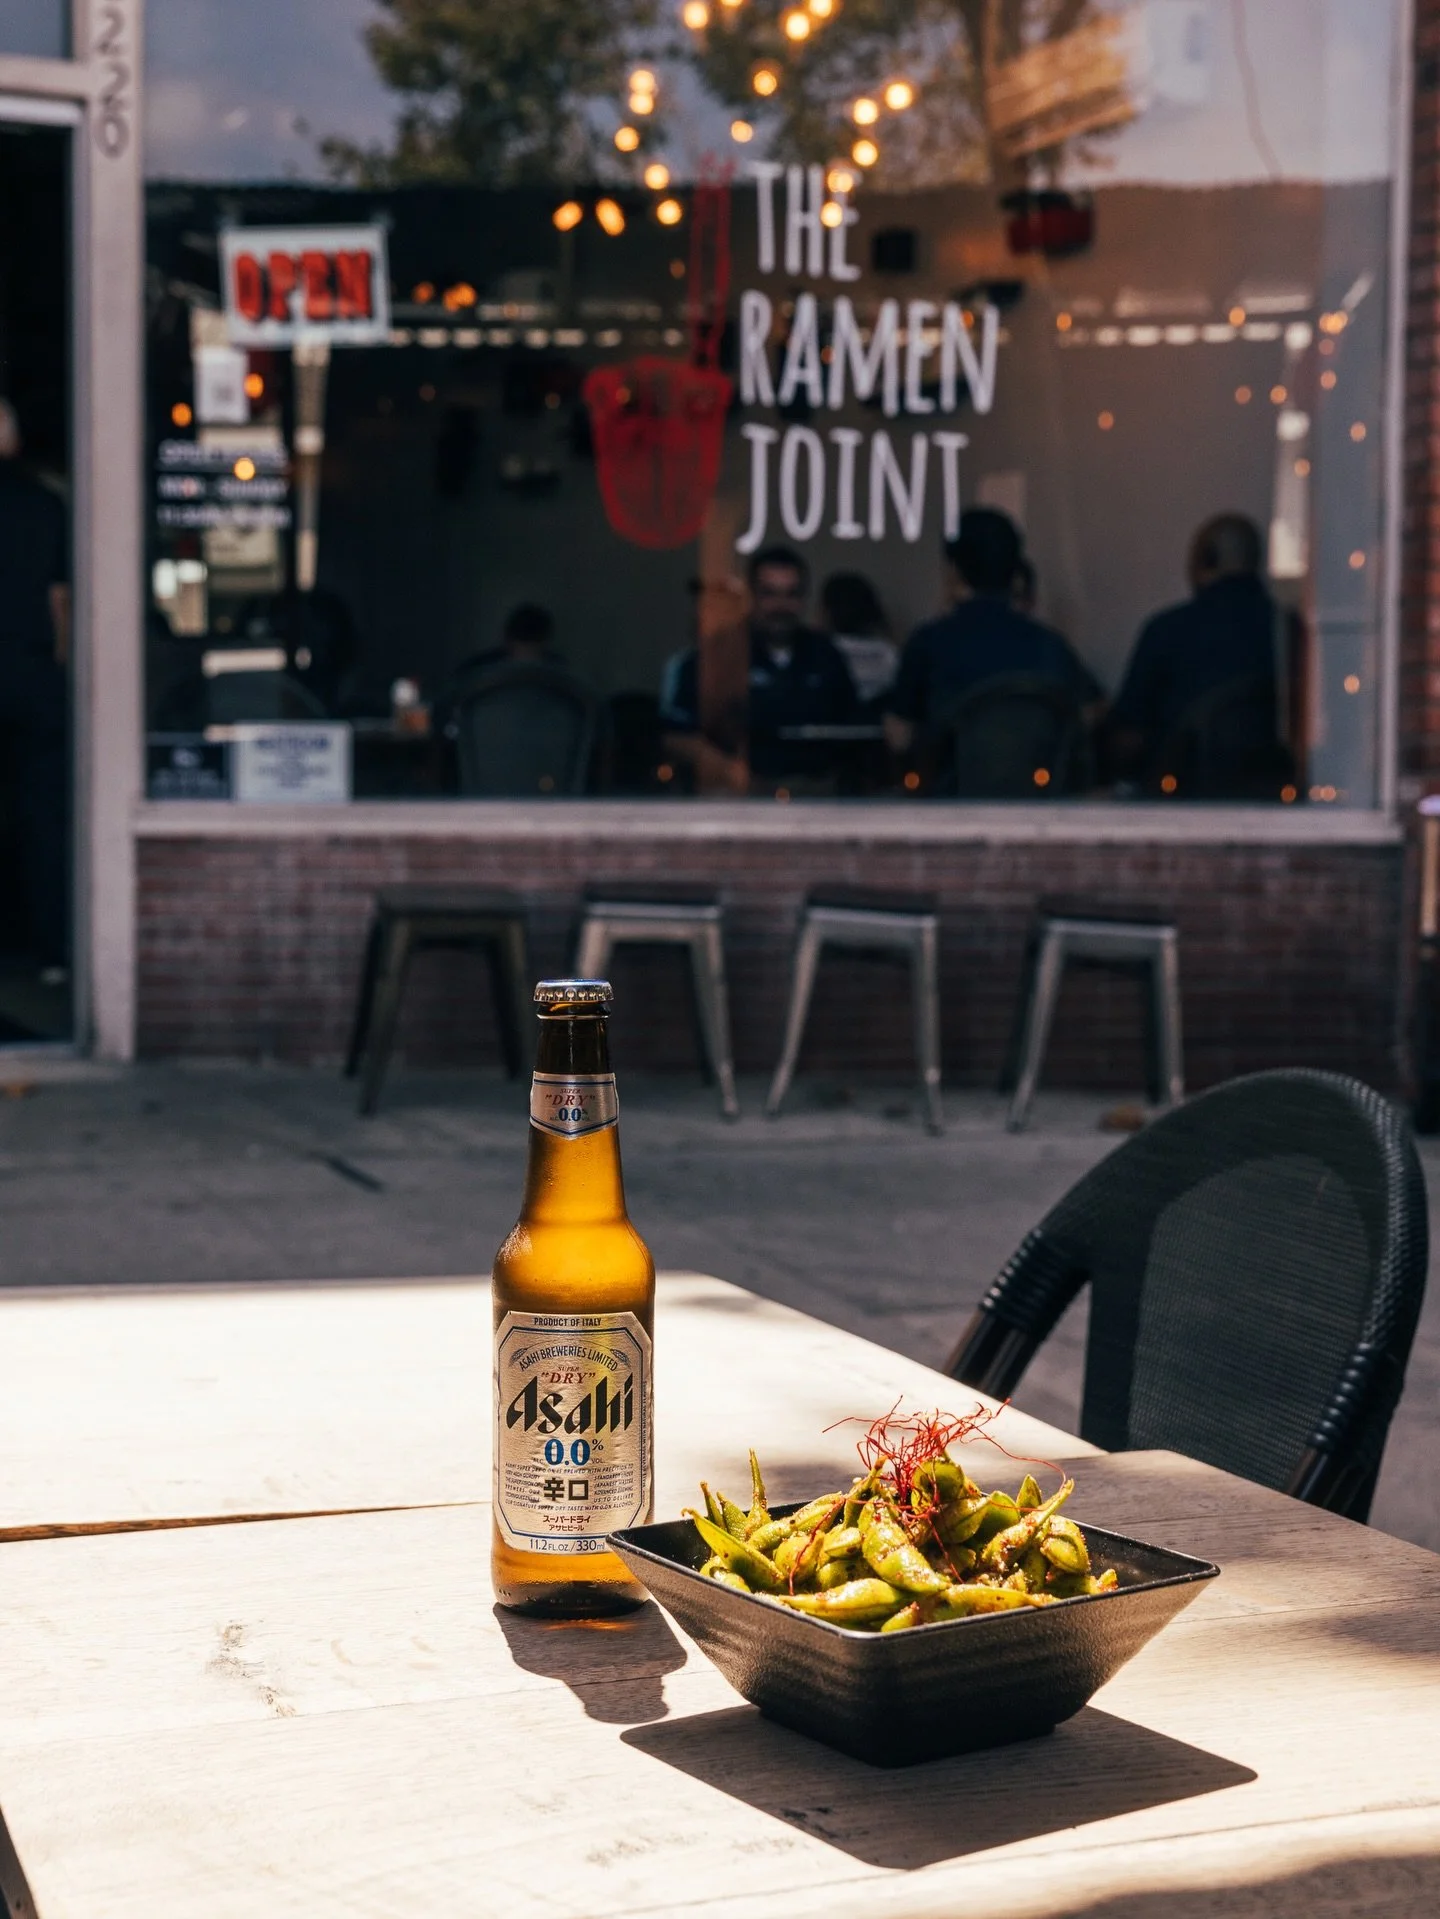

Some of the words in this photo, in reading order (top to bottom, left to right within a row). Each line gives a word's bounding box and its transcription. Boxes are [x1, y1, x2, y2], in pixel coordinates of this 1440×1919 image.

[752, 162, 863, 281] THE
[234, 247, 374, 322] OPEN
[740, 289, 1000, 417] RAMEN
[735, 424, 970, 556] JOINT
[534, 1317, 568, 1327] PRODUCT
[570, 1318, 581, 1327] OF
[582, 1317, 602, 1327] ITALY
[519, 1351, 540, 1371] ASAHI
[541, 1345, 586, 1359] BREWERIES
[587, 1350, 619, 1371] LIMITED
[505, 1372, 634, 1435] Asahi
[543, 1477, 589, 1501] 辛口
[543, 1515, 591, 1523] スーパードライ
